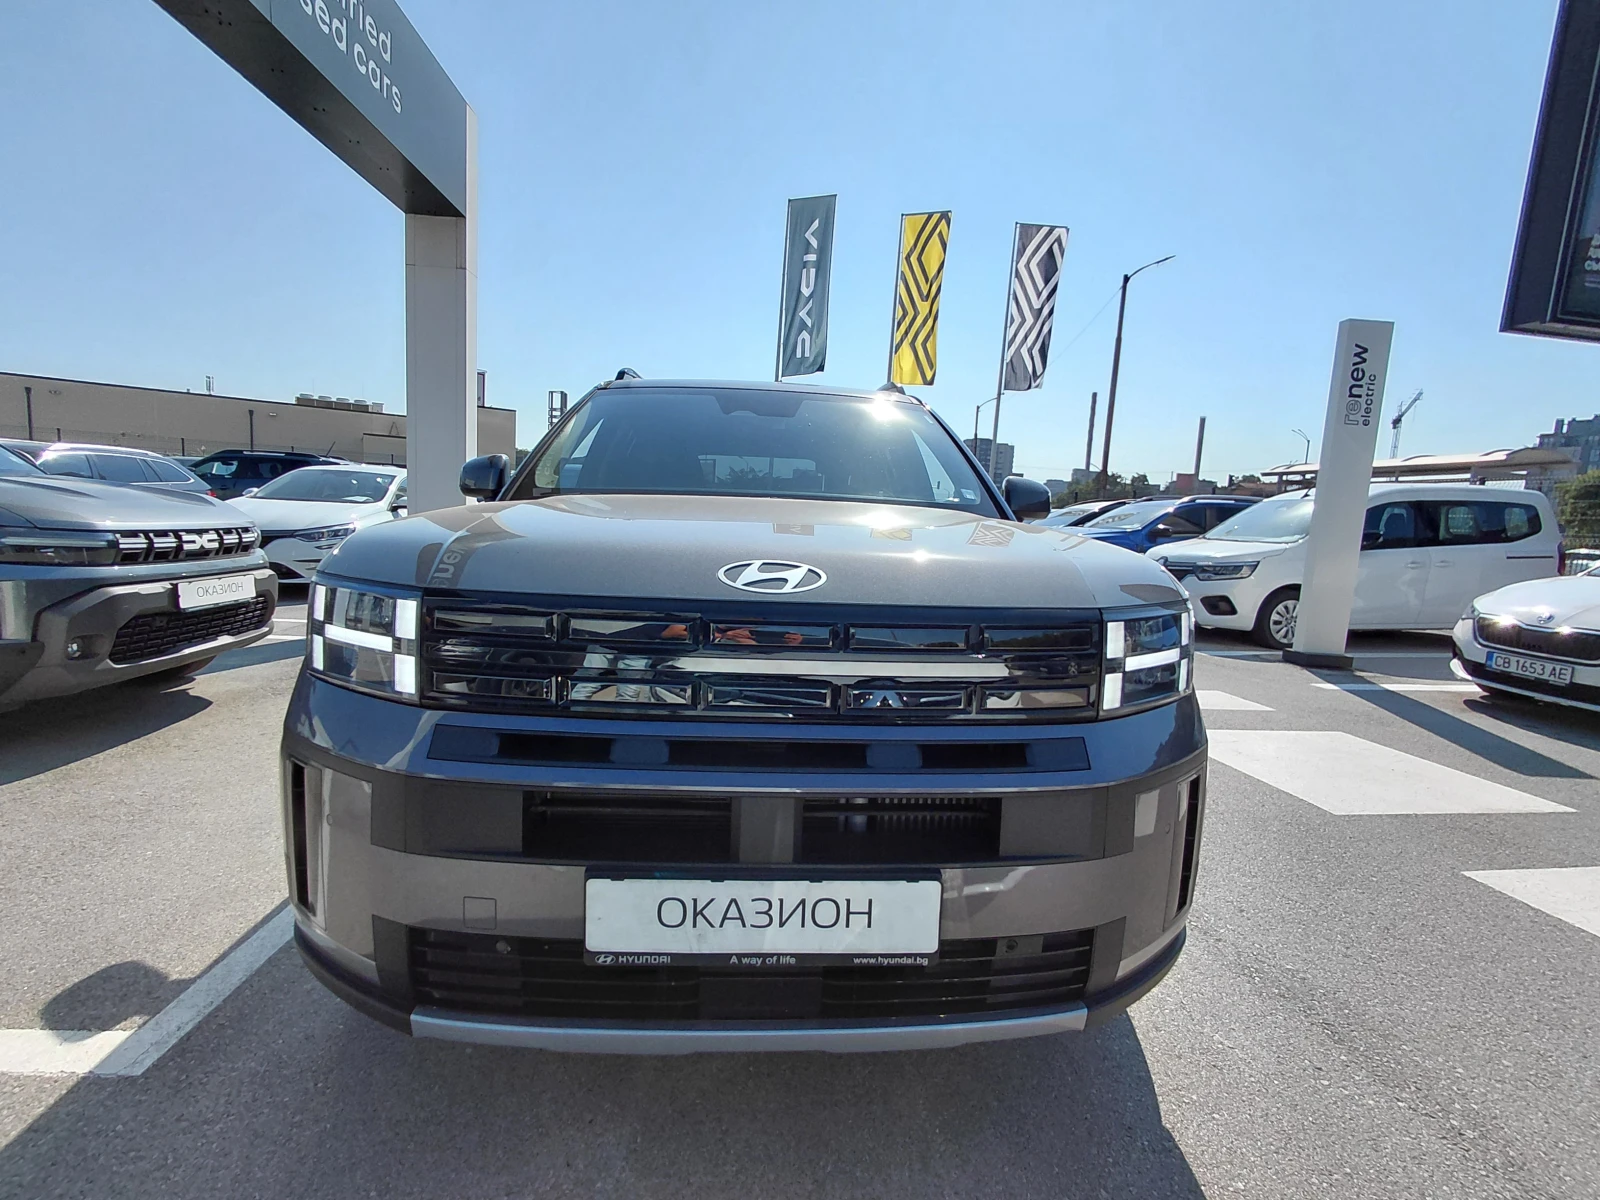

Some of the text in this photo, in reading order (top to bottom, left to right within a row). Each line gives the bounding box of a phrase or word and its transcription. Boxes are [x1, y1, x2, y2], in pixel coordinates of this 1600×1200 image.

[338, 0, 392, 64] fied
[354, 43, 402, 114] cars
[796, 218, 819, 358] DACIA
[1344, 343, 1369, 426] renew
[1361, 373, 1377, 427] electric
[196, 582, 244, 598] ОКАЗИОН
[1494, 655, 1569, 680] CB 1653 AE
[656, 897, 873, 929] ОКАЗИОН
[618, 955, 671, 964] HYUNDAI
[729, 955, 796, 966] A way of life
[853, 956, 929, 966] www.hyundai.bg
